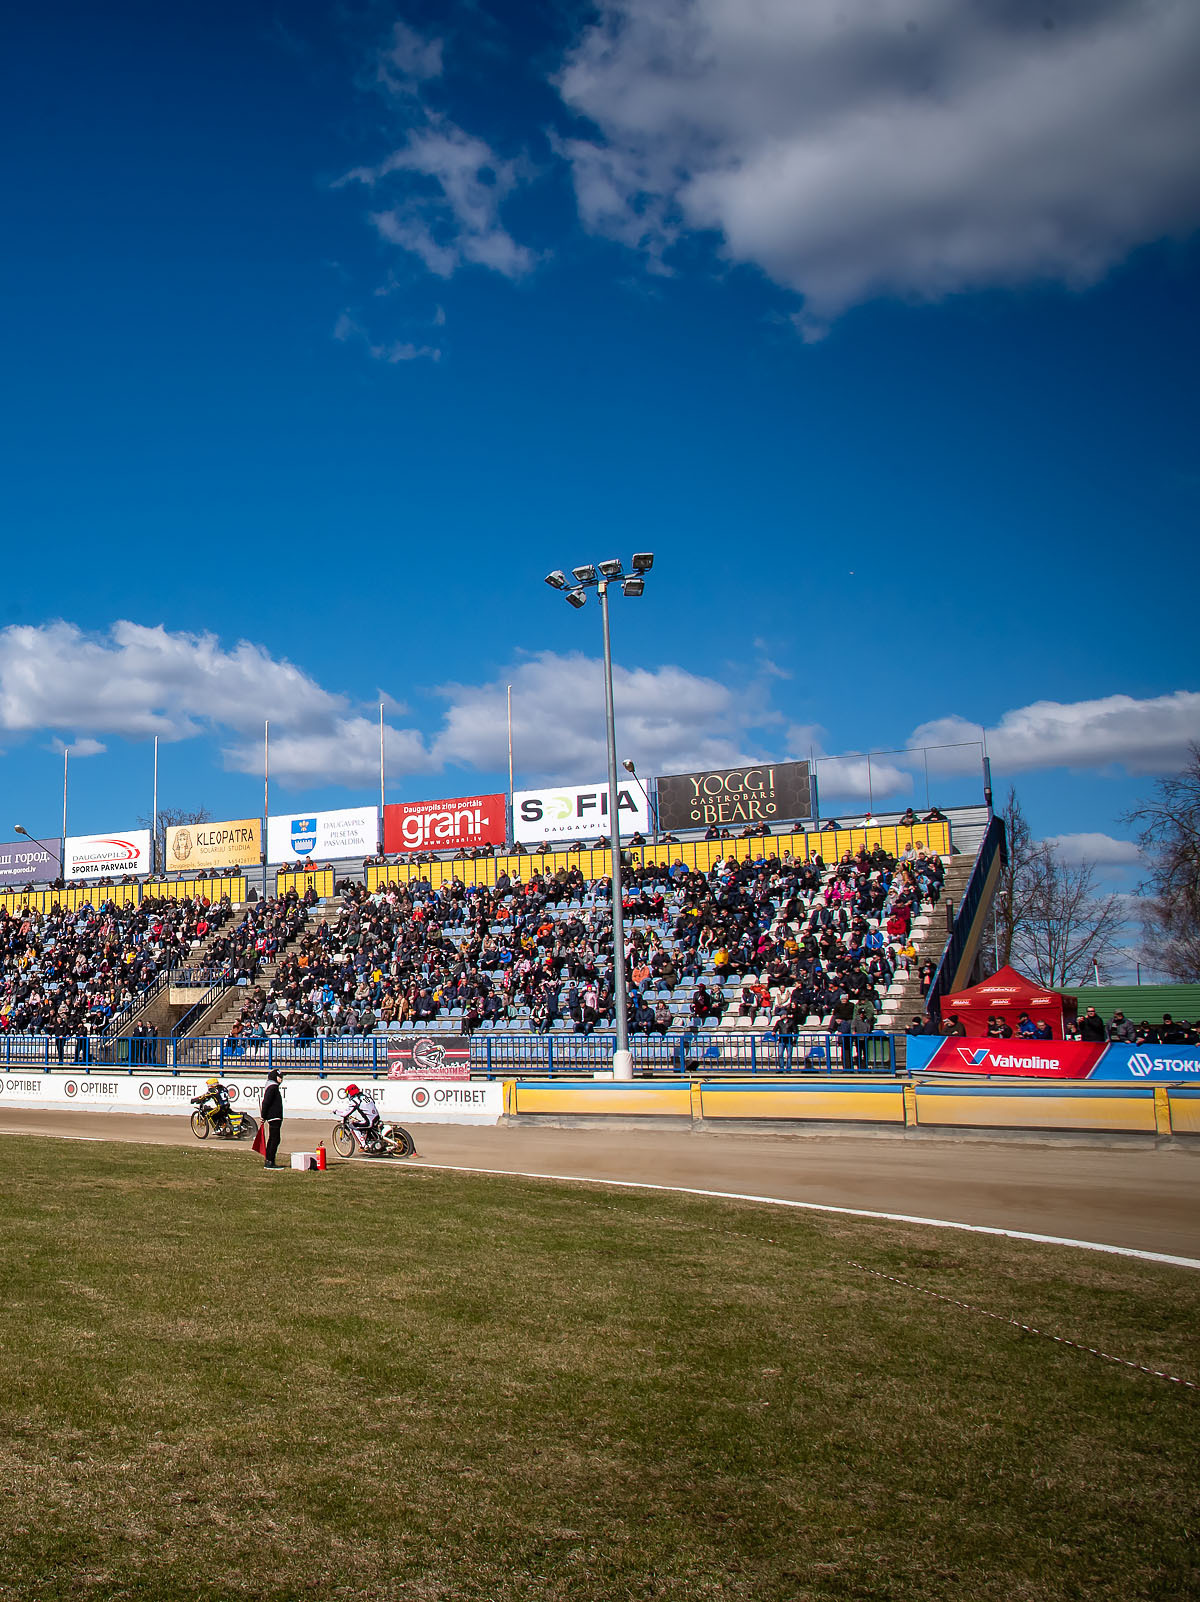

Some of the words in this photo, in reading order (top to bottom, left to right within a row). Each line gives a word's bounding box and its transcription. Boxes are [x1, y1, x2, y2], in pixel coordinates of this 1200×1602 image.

[690, 769, 774, 796] YOGGI
[691, 790, 775, 806] GASTROBARS
[403, 804, 441, 814] Daugavpils
[704, 800, 768, 824] BEAR
[545, 823, 608, 832] DAUGAVPIL
[197, 828, 254, 846] KLEOPATRA
[72, 851, 127, 862] DAUGAVPILS
[72, 865, 99, 874] SPORTA
[101, 861, 138, 872] PĀRVALDE
[989, 1054, 1060, 1070] Valvoline
[6, 1080, 42, 1091] OPTIBET
[80, 1082, 119, 1094] OPTIBET
[156, 1084, 197, 1097] OPTIBET
[243, 1086, 287, 1099] OPTT
[434, 1089, 486, 1103] OPTIBET
